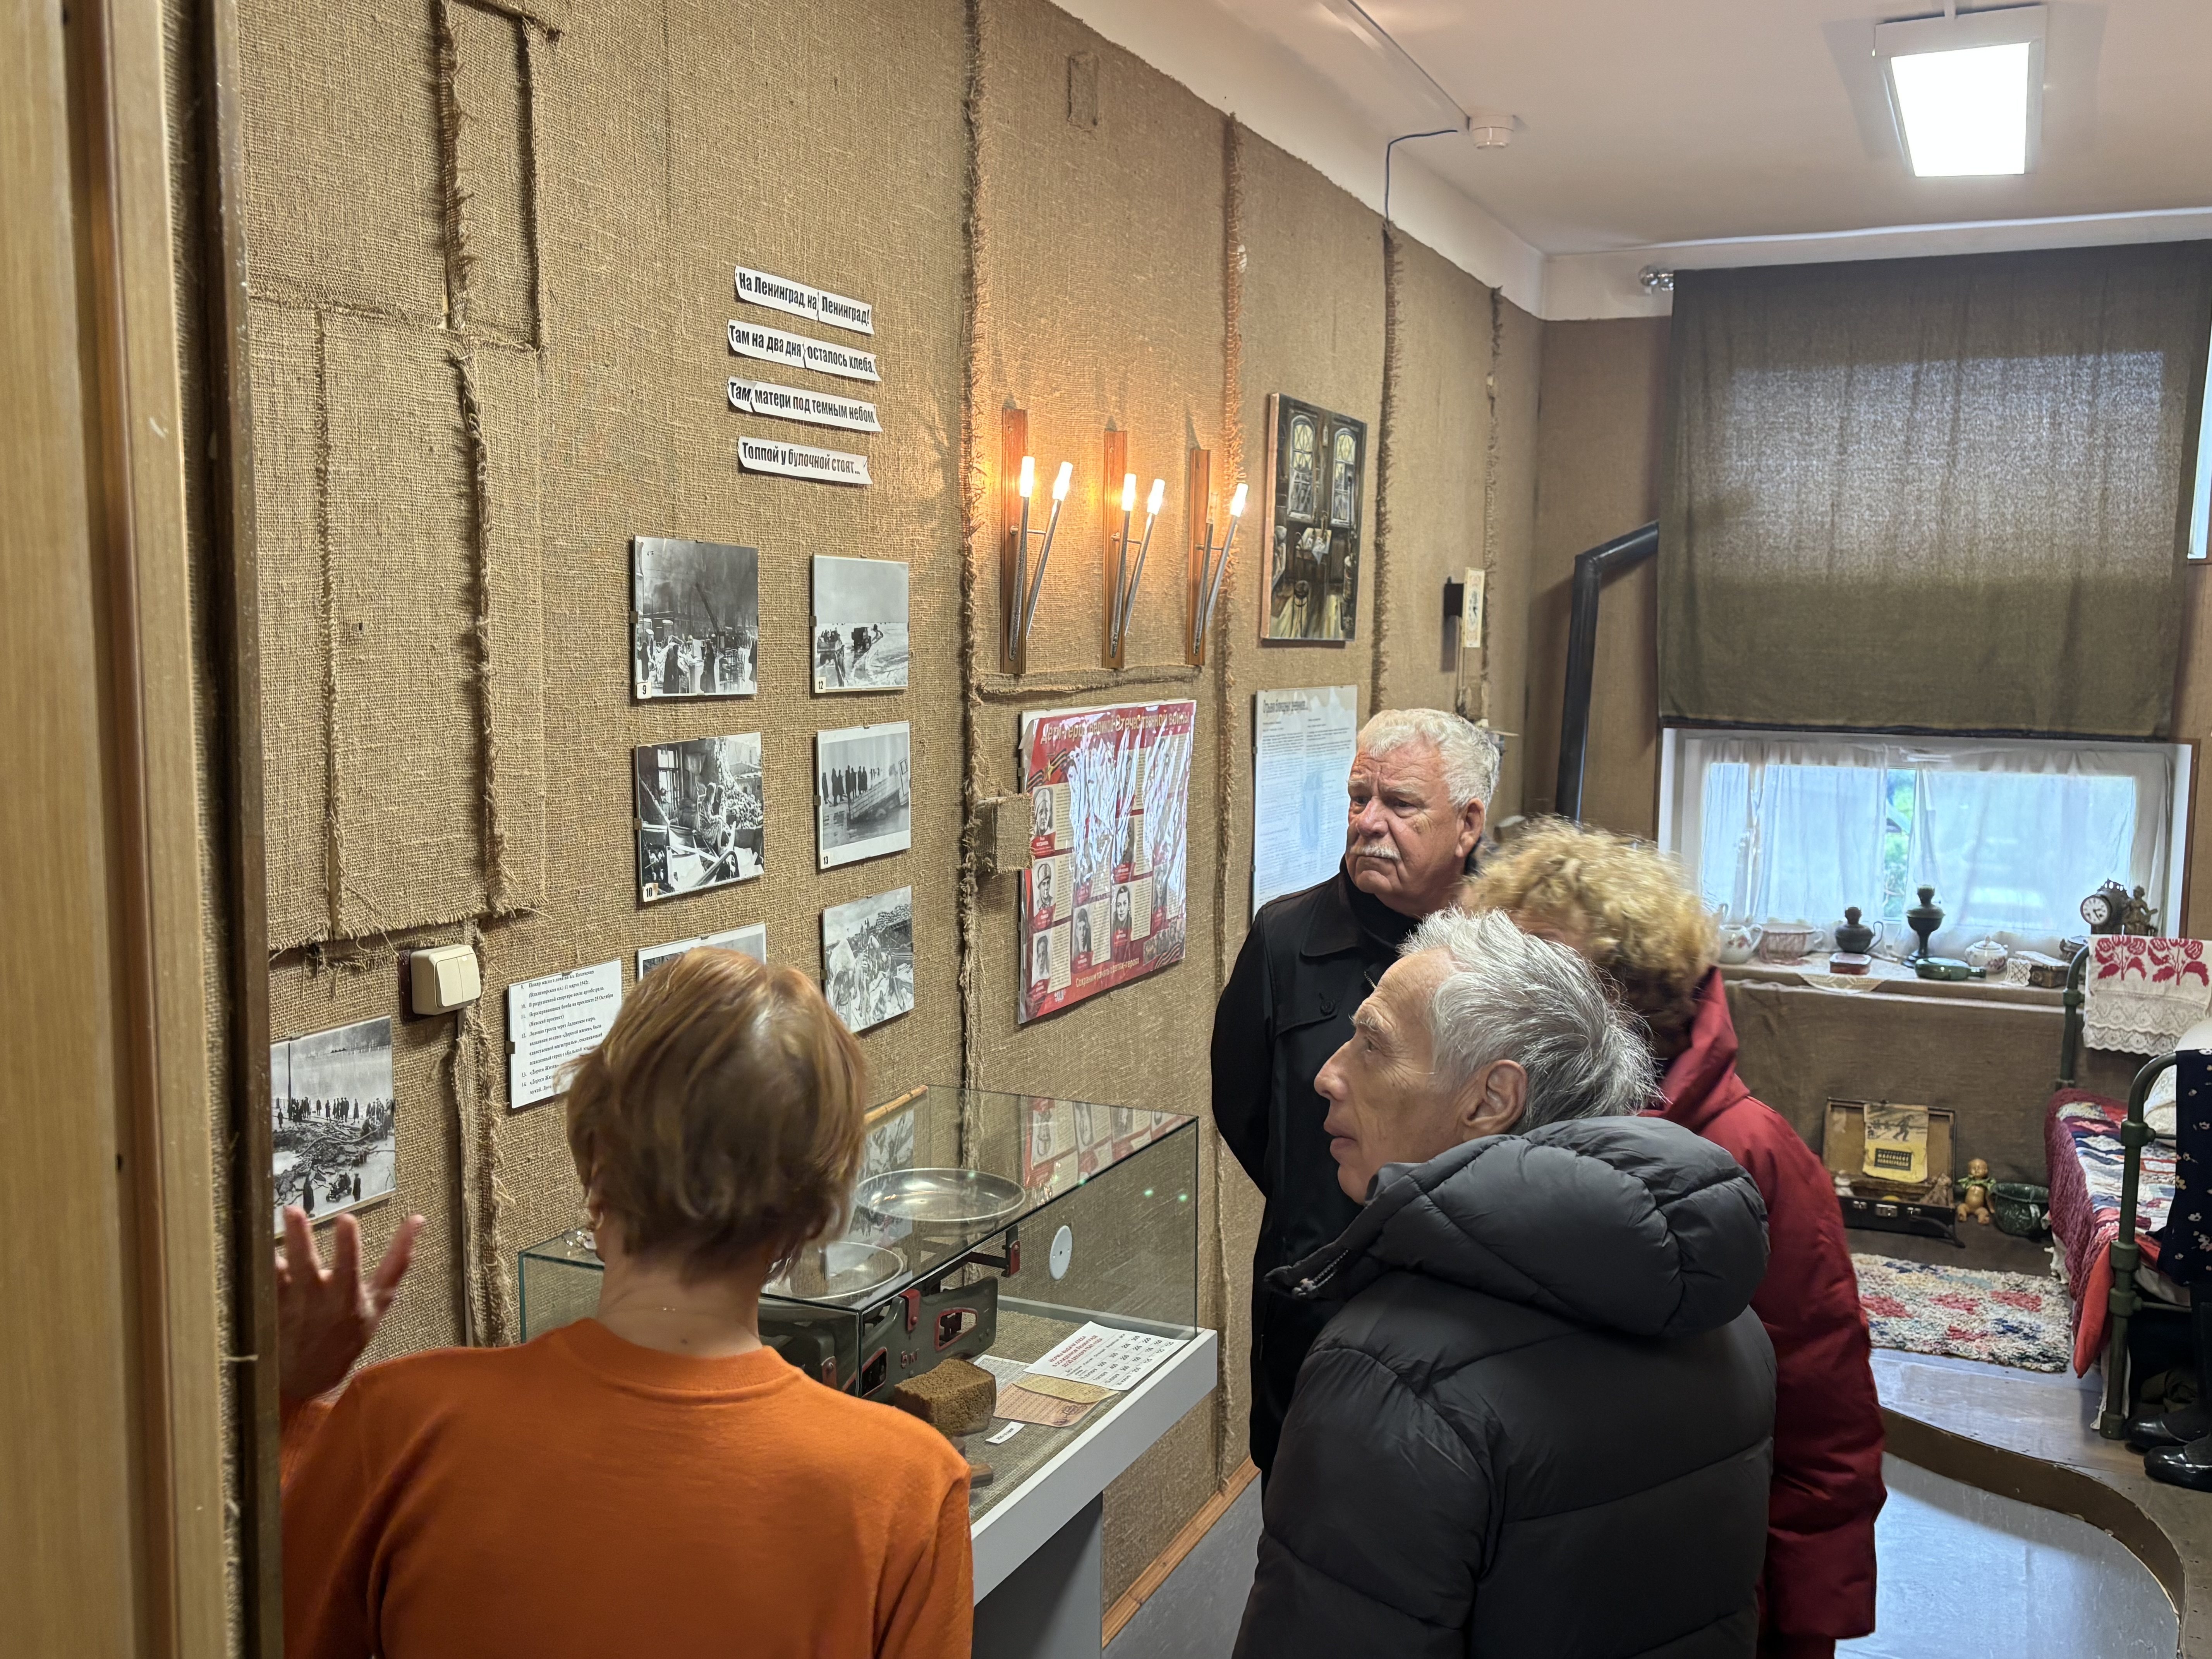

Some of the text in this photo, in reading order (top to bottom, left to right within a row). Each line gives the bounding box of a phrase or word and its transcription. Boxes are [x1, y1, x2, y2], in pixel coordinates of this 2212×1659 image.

[739, 272, 752, 292] На
[807, 292, 817, 310] на
[821, 295, 870, 326] Ленинград!
[729, 325, 876, 374] Там на два дня осталось хлеба,
[730, 382, 875, 424] Там матери под темным небом
[742, 441, 779, 463] Толпой
[781, 450, 787, 465] у
[788, 448, 830, 471] булочной
[642, 684, 647, 695] 9
[818, 680, 823, 689] 12
[823, 855, 828, 865] 13
[646, 887, 653, 898] 10
